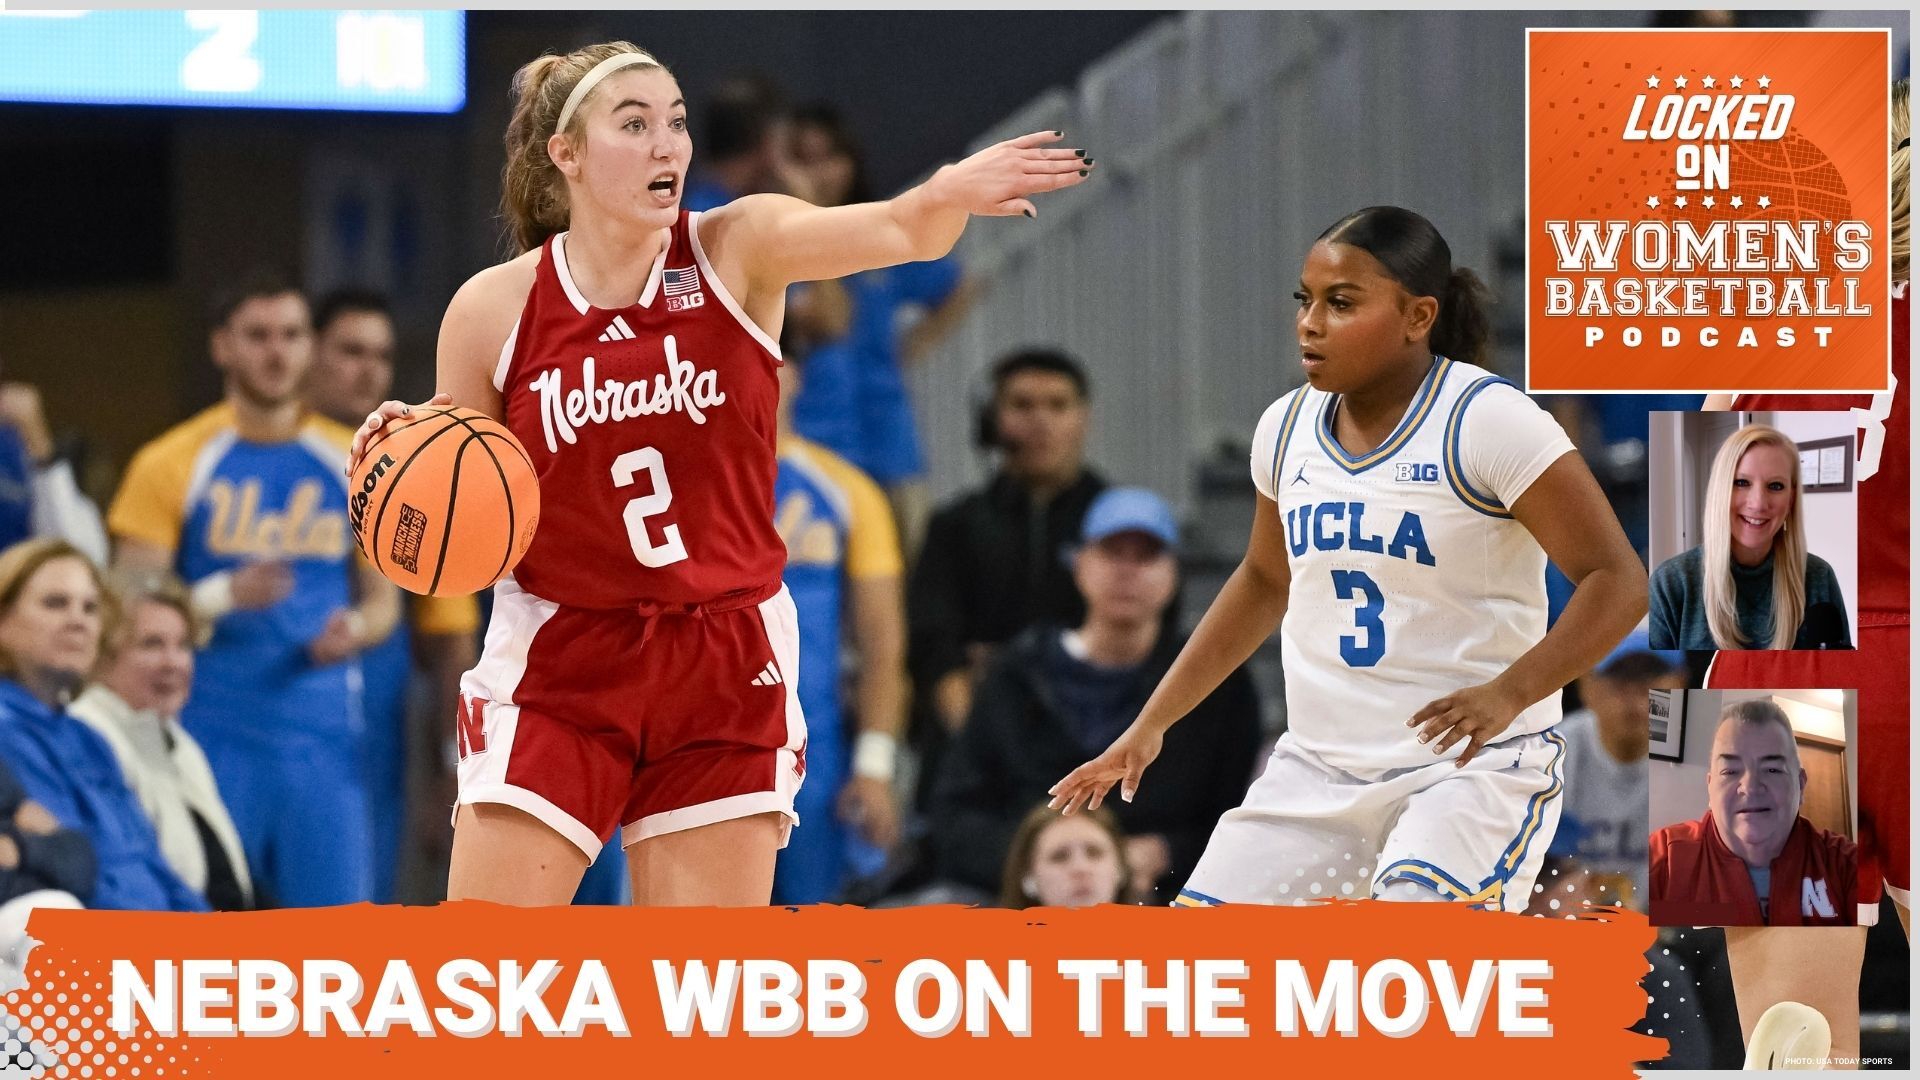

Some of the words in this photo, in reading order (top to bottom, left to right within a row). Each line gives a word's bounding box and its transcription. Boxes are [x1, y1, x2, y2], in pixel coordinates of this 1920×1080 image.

[529, 334, 726, 453] Nebraska
[392, 522, 409, 558] MARCH
[403, 508, 424, 559] MADNESS
[610, 446, 689, 568] 2
[1287, 501, 1436, 567] UCLA
[1330, 569, 1386, 667] 3
[458, 691, 487, 761] N
[1802, 876, 1838, 918] N
